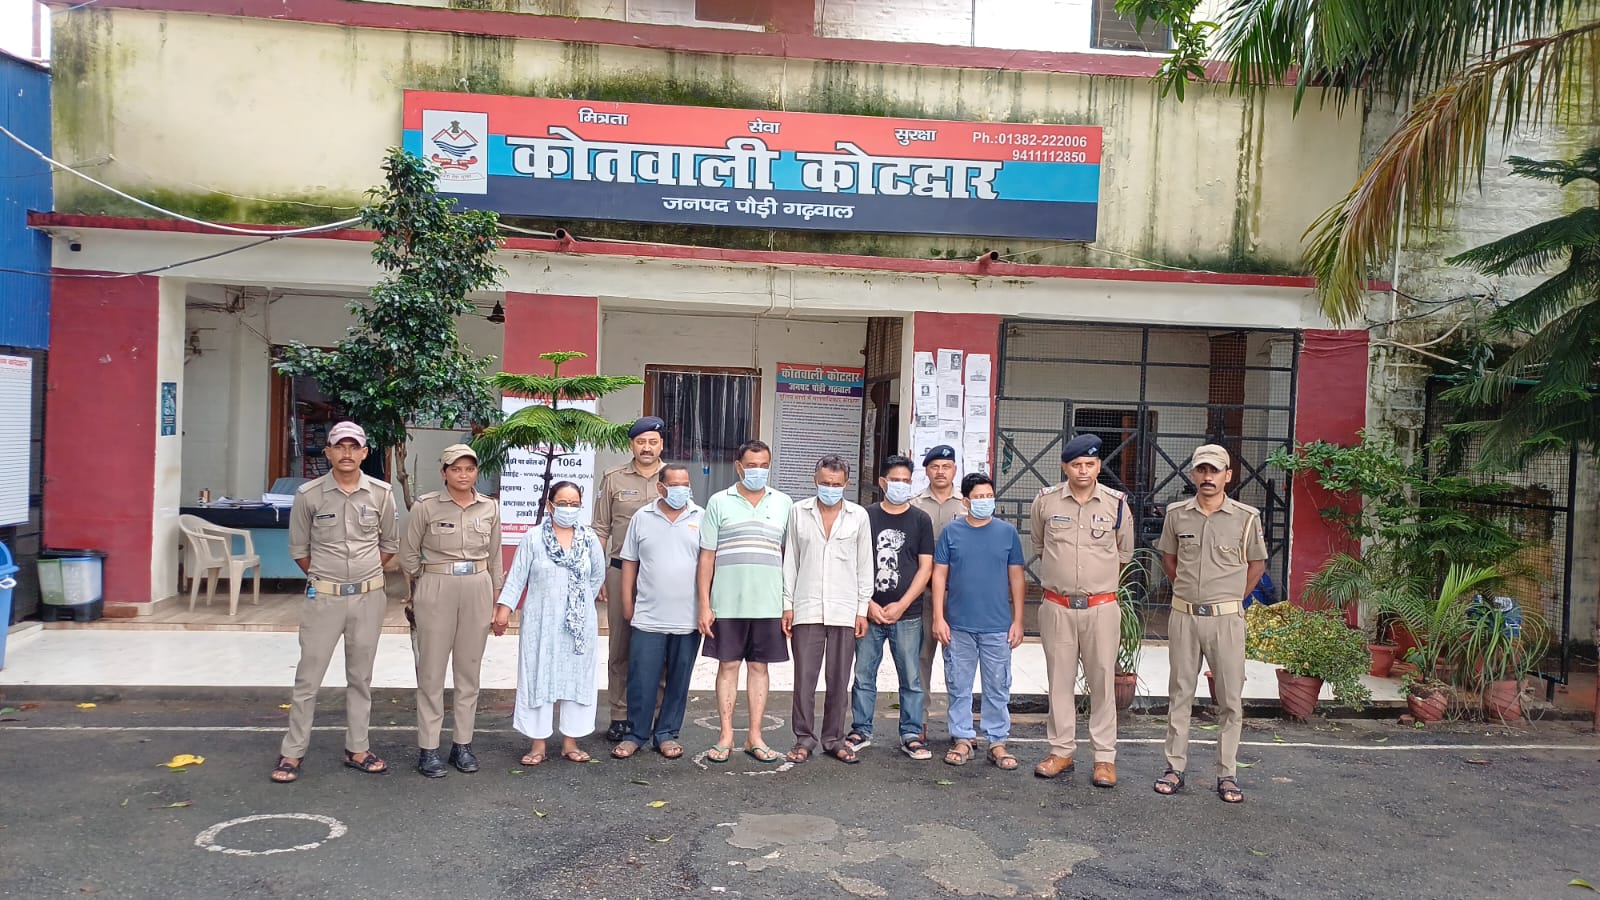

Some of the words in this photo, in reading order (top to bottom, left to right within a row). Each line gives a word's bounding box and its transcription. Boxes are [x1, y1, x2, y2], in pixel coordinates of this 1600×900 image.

[578, 106, 629, 126] मित्रता
[748, 118, 781, 134] सेवा
[894, 127, 937, 147] सुरक्षा
[973, 131, 1088, 148] Ph.:01382-222006
[505, 125, 780, 190] कोतवाली
[796, 141, 1003, 199] कोटद्वार
[1012, 149, 1087, 163] 9411112850
[662, 196, 731, 213] जनपद
[735, 195, 779, 219] पौड़ी
[783, 202, 855, 221] गढ़वाल
[781, 365, 824, 381] कोतवाली
[788, 382, 810, 392] जनपद
[558, 459, 582, 467] 1064
